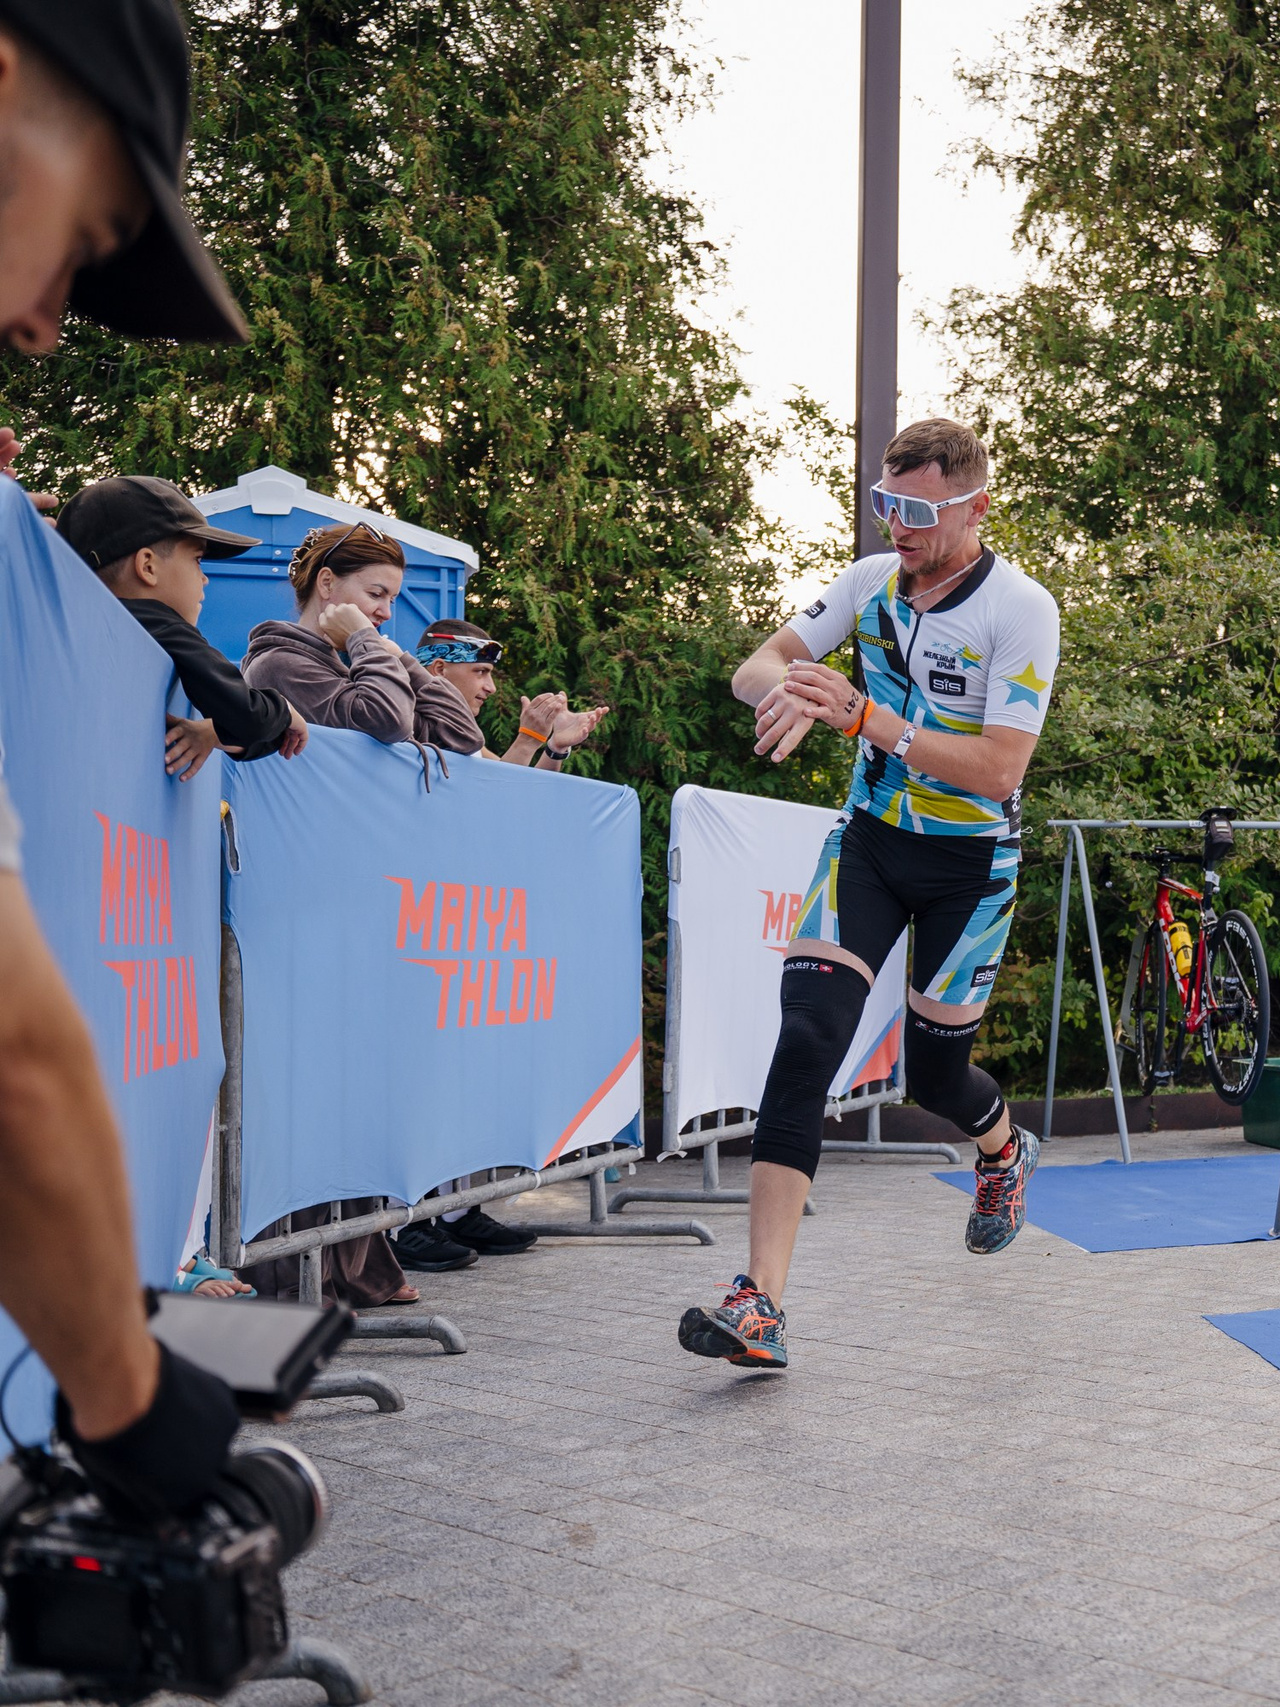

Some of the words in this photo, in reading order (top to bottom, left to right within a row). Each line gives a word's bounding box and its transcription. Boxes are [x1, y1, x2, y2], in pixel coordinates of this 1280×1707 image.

[922, 650, 957, 665] ЖЕЛЕЗНЫЙ
[936, 660, 956, 671] КРЫМ
[844, 691, 860, 715] 241
[382, 875, 528, 951] MRIYA
[398, 957, 557, 1029] THLON
